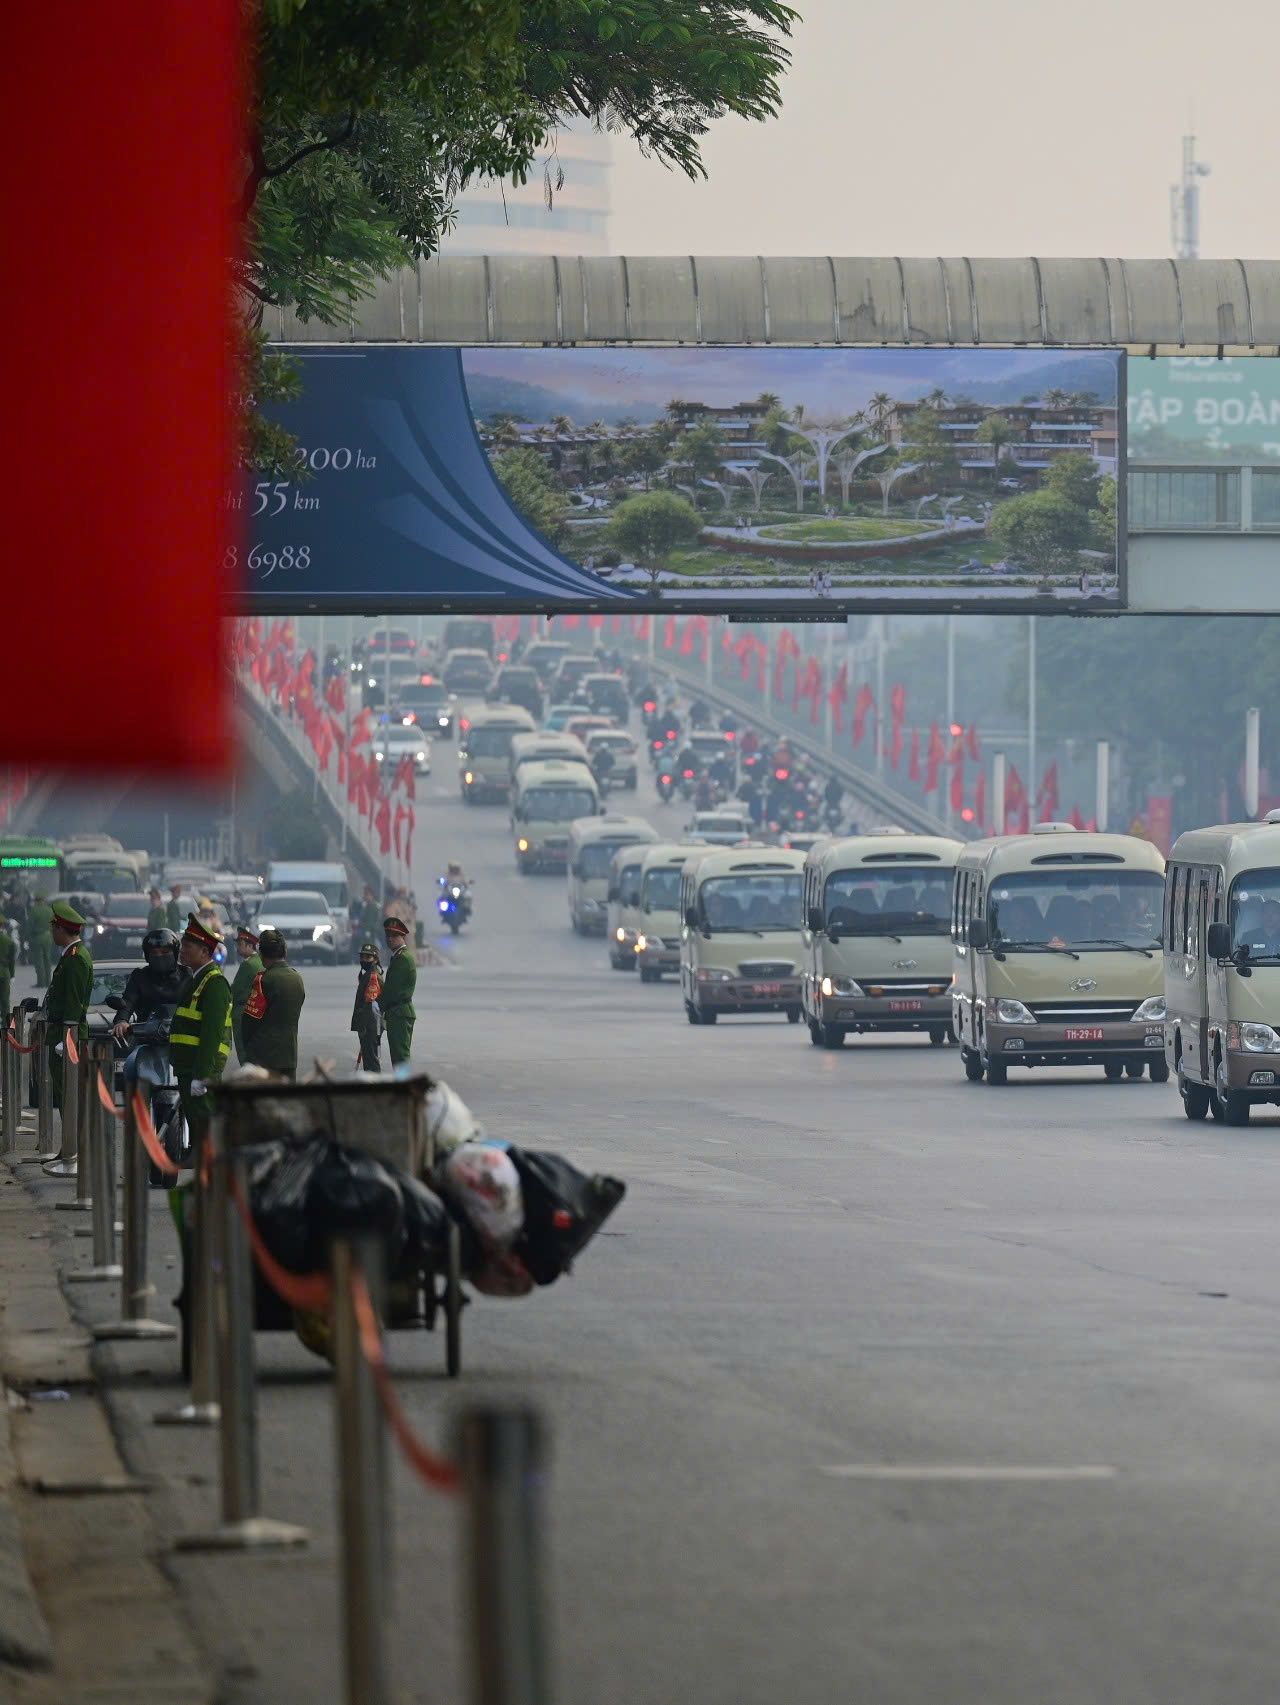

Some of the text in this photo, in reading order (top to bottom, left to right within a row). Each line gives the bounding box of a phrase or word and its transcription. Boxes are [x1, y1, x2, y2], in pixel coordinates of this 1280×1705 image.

[295, 447, 352, 470] 200
[356, 449, 377, 469] ha
[250, 481, 290, 517] 55
[294, 490, 320, 510] km
[247, 543, 311, 579] 6988
[1066, 1029, 1103, 1039] TH-29-14
